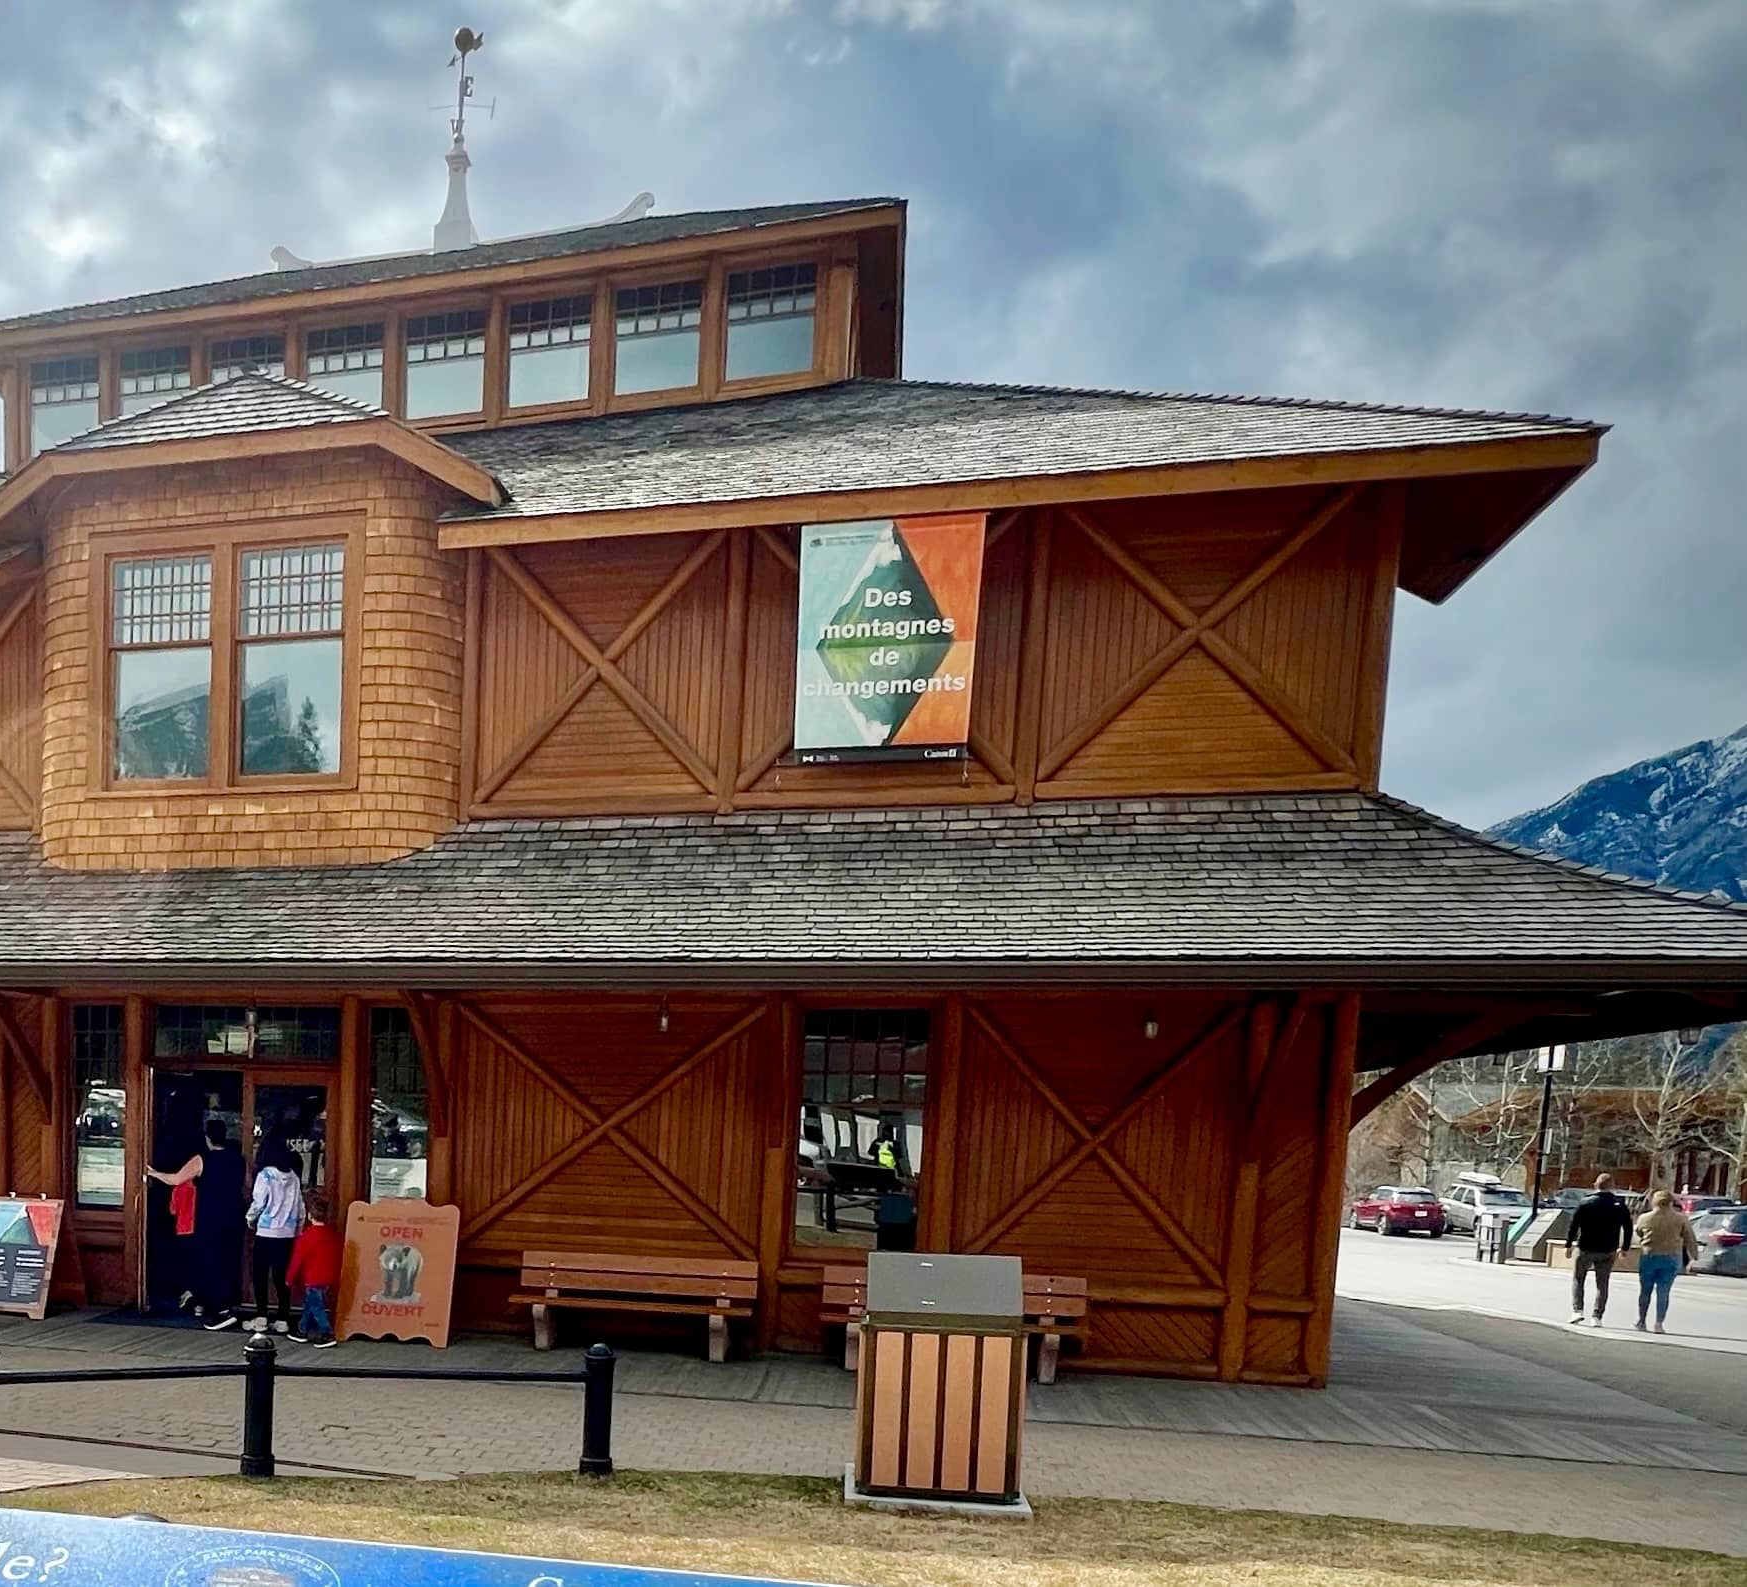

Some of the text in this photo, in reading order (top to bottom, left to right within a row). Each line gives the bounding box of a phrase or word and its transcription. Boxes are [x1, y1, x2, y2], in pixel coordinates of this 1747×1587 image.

[864, 587, 913, 608] Des
[820, 617, 955, 640] montagnes
[869, 646, 900, 666] de
[803, 672, 966, 699] changements
[380, 1226, 423, 1239] OPEN
[361, 1302, 425, 1318] OUVERT
[244, 1548, 275, 1557] PARK
[278, 1551, 323, 1572] MUSEUM
